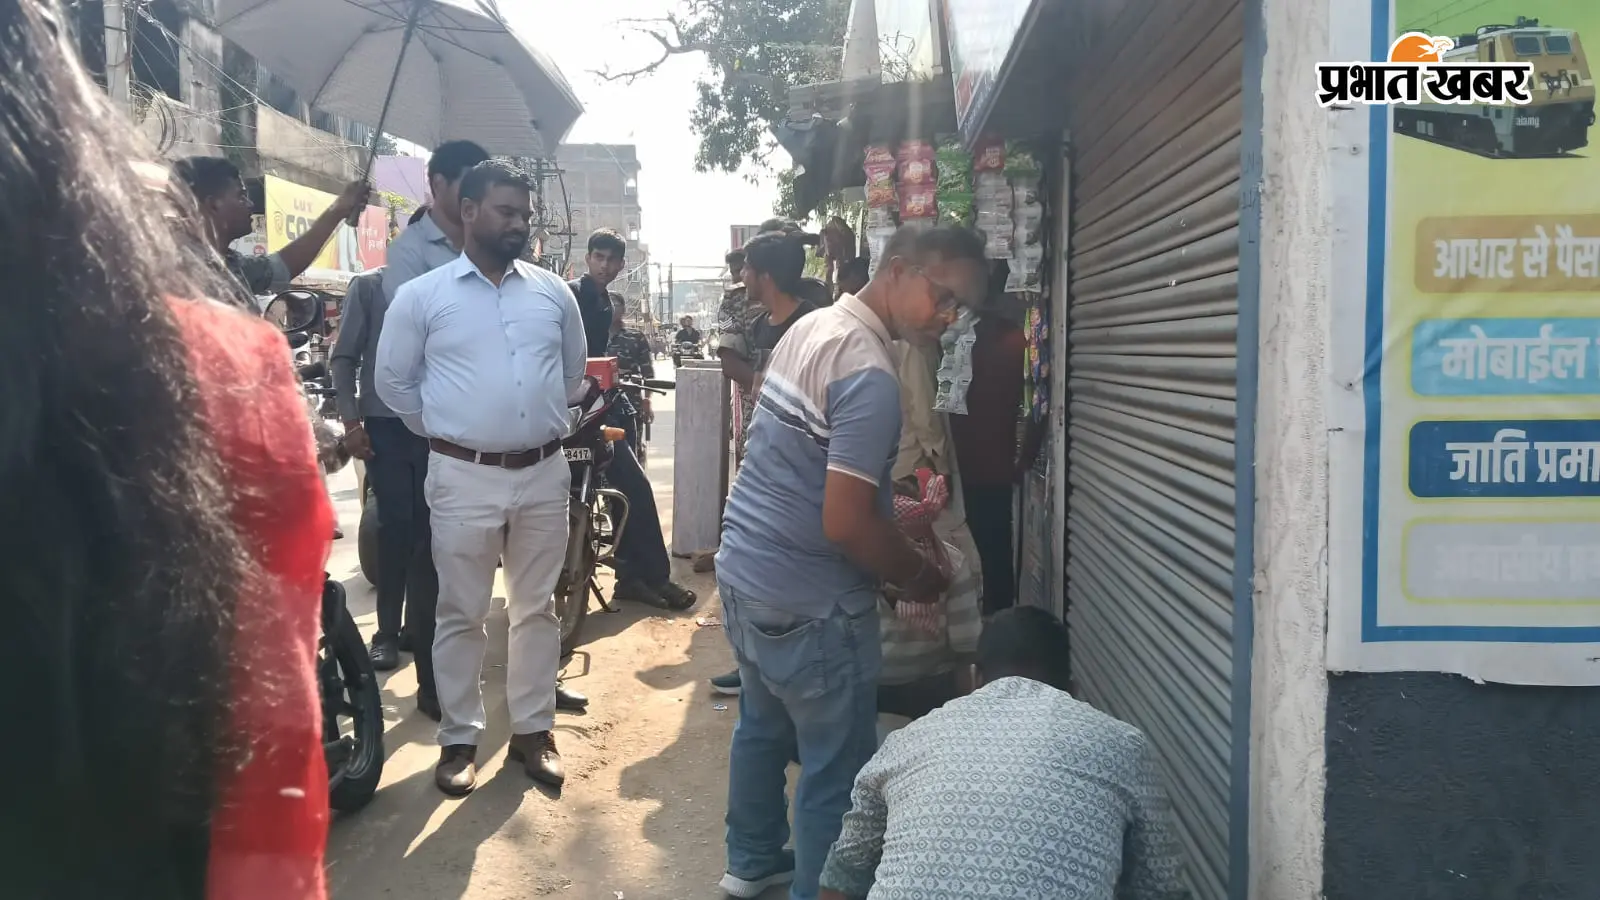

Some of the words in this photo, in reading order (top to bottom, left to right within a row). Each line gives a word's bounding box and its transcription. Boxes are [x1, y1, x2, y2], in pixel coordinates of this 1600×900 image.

[1432, 237, 1517, 279] आधार
[1520, 224, 1551, 278] से
[1438, 324, 1591, 384] मोबाईल
[1445, 428, 1530, 483] जाति
